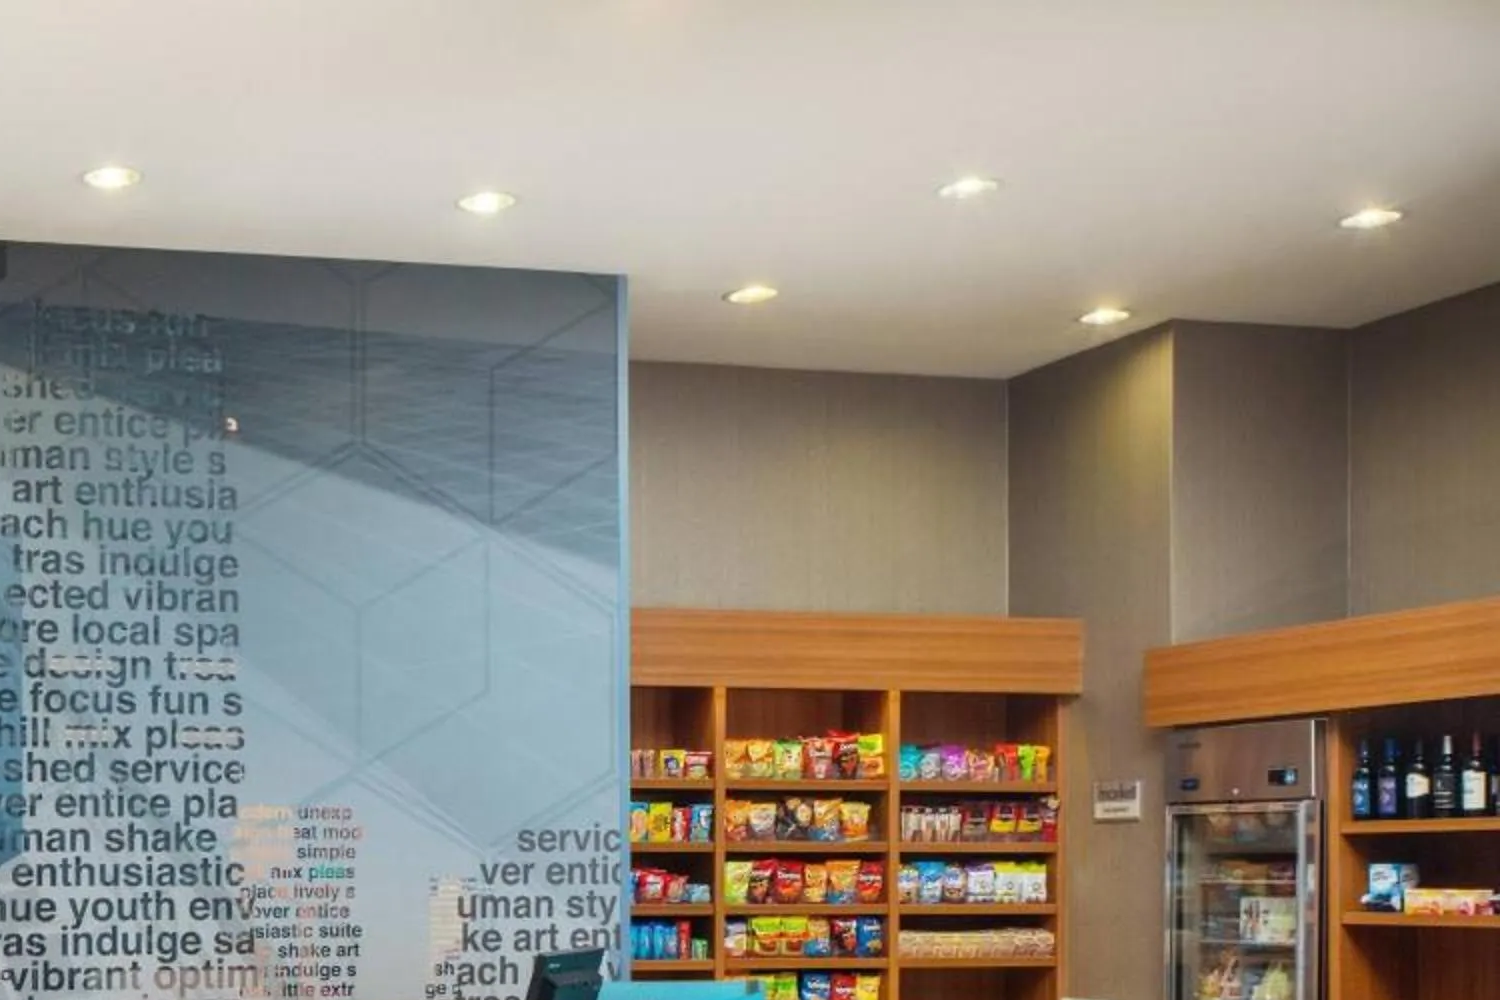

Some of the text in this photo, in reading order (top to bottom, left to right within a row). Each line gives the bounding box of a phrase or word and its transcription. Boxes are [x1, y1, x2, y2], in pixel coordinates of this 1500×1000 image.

[54, 406, 169, 439] entice
[104, 443, 194, 479] style
[208, 450, 227, 475] s
[12, 475, 238, 510] art enthusia
[83, 510, 152, 541] hue
[164, 518, 233, 549] you
[12, 543, 239, 586] tras indulge
[4, 579, 239, 612] ected vibran
[73, 613, 160, 646] local
[174, 621, 239, 653] spa
[30, 681, 136, 714] focus
[149, 684, 208, 714] fun
[223, 692, 242, 716] s
[55, 787, 170, 818] entice
[184, 788, 237, 826] pla
[105, 822, 217, 853] shake
[297, 844, 356, 860] simple
[517, 824, 621, 853] servic
[12, 856, 245, 887] enthusiastic
[480, 862, 535, 885] ver
[69, 890, 175, 929] youth
[189, 896, 254, 921] env
[296, 903, 350, 918] entice
[458, 890, 617, 925] uman sty
[61, 925, 201, 963] indulge
[214, 930, 255, 955] sa
[319, 923, 362, 938] suite
[462, 922, 502, 952] ke
[513, 923, 559, 952] art
[277, 942, 360, 958] shake art
[10, 958, 258, 996] vibrant optim
[274, 962, 341, 981] indulge
[457, 956, 519, 985] ach
